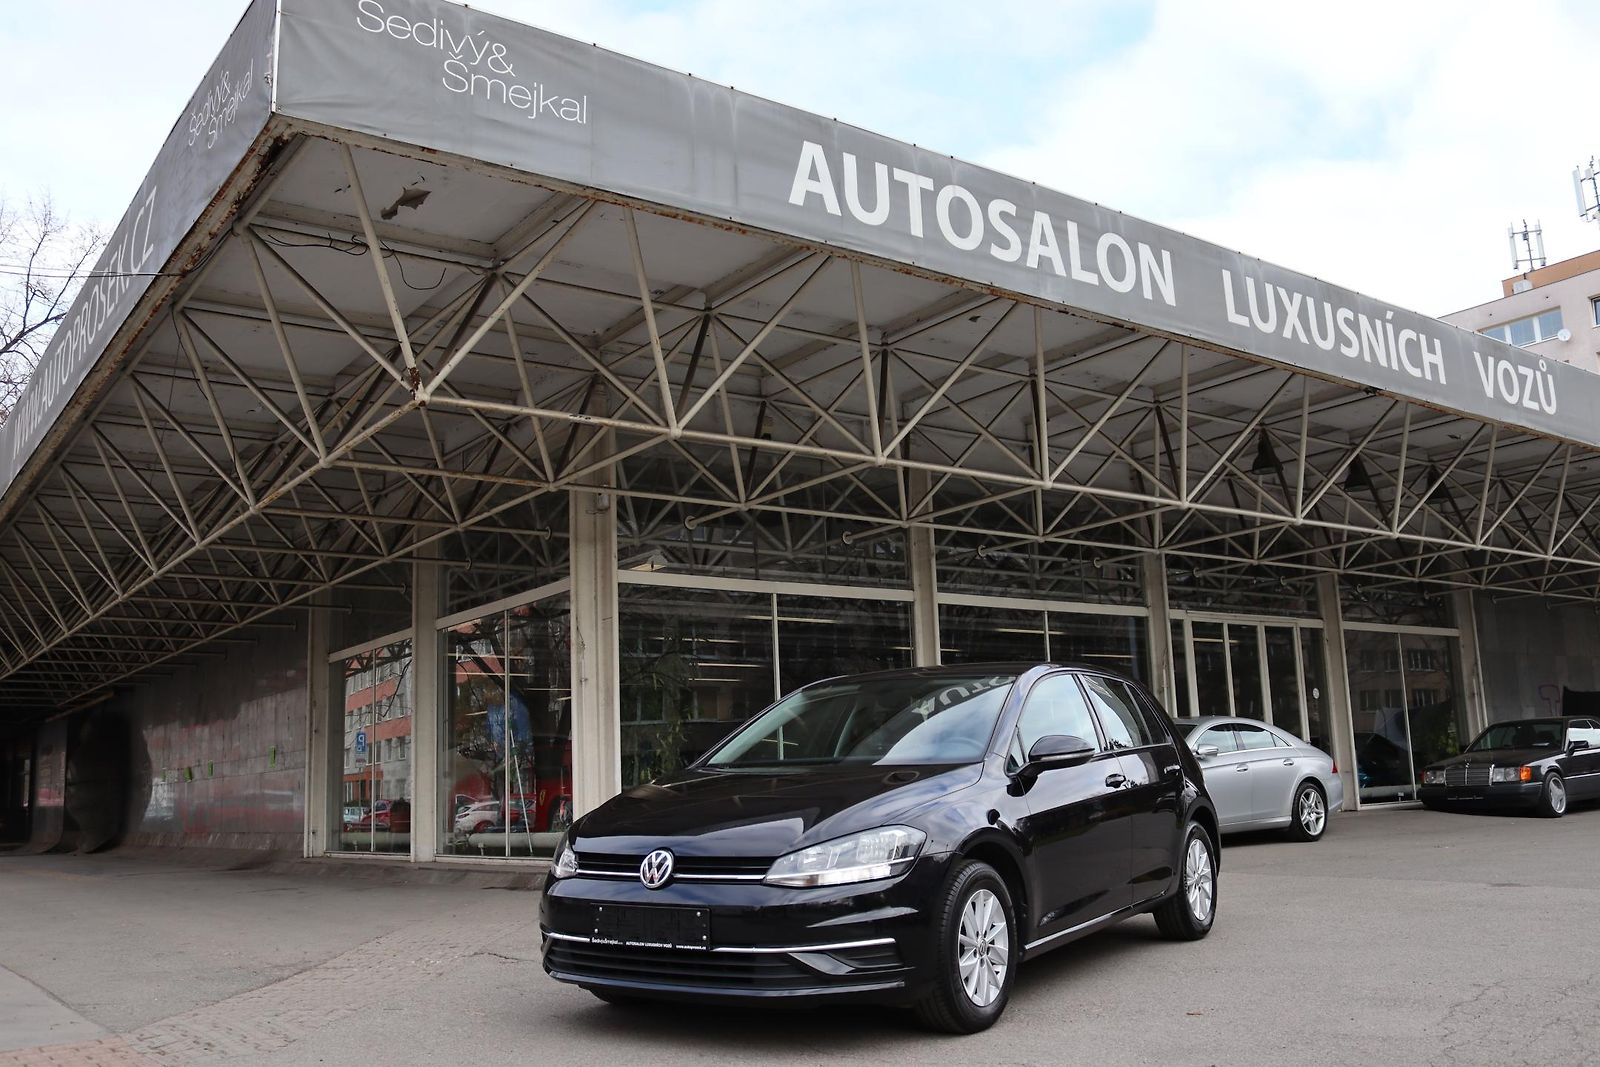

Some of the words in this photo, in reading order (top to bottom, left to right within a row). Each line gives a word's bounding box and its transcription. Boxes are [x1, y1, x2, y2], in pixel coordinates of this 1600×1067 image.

[442, 51, 588, 125] Šmejkal
[12, 185, 158, 461] WWW.AUTOPROSEK.CZ
[788, 140, 1176, 307] AUTOSALON
[1222, 269, 1447, 385] LUXUSNÍCH
[1473, 358, 1558, 416] VOZŮ
